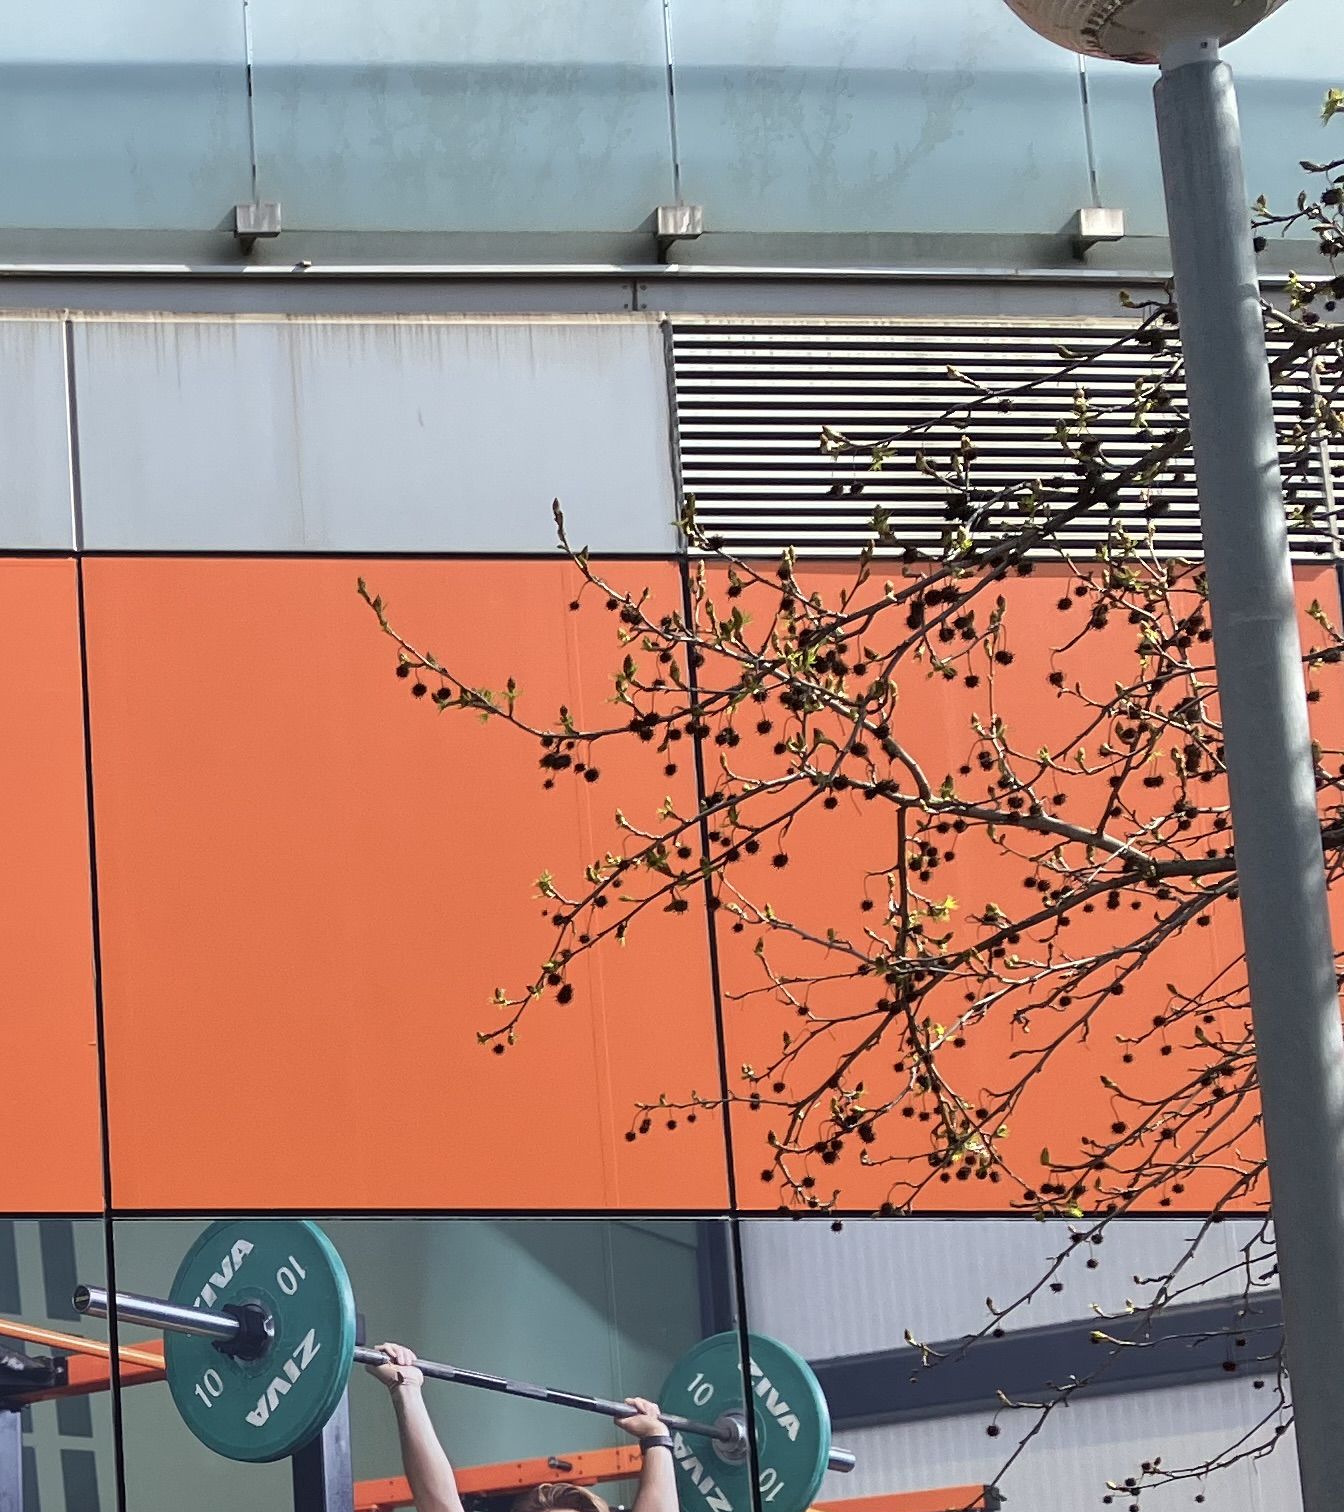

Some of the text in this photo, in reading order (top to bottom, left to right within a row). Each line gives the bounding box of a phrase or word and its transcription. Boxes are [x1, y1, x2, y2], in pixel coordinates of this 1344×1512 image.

[192, 1239, 254, 1308] IVA
[275, 1255, 307, 1296] 10
[193, 1367, 224, 1408] 10
[244, 1327, 321, 1428] ZIVA
[686, 1372, 715, 1407] 10
